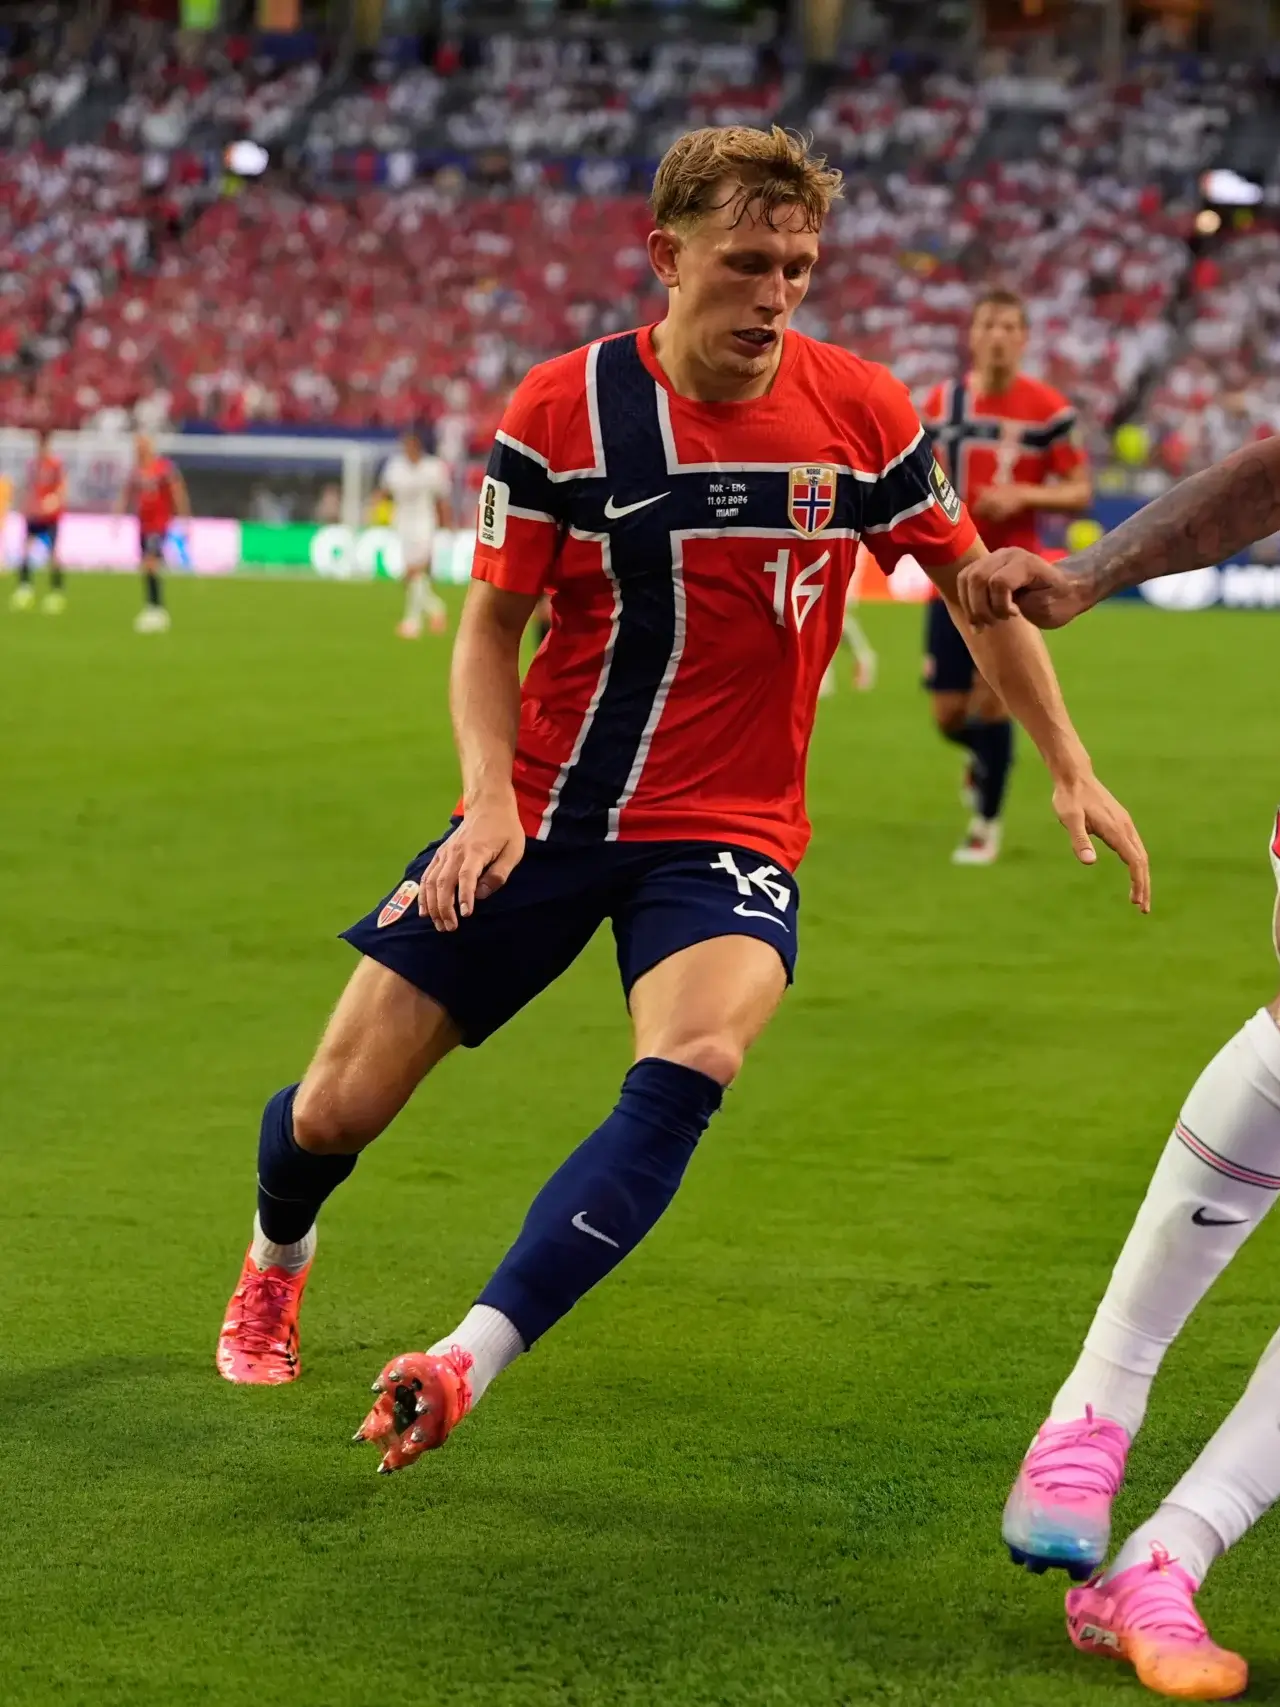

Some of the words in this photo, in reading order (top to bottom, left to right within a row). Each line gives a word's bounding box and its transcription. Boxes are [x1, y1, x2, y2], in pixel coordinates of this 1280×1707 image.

[709, 484, 723, 493] NOR
[731, 483, 746, 492] ENG
[707, 495, 748, 505] 11.07.2026
[716, 508, 739, 517] MIAMI
[763, 548, 829, 633] 16
[710, 852, 790, 912] 16
